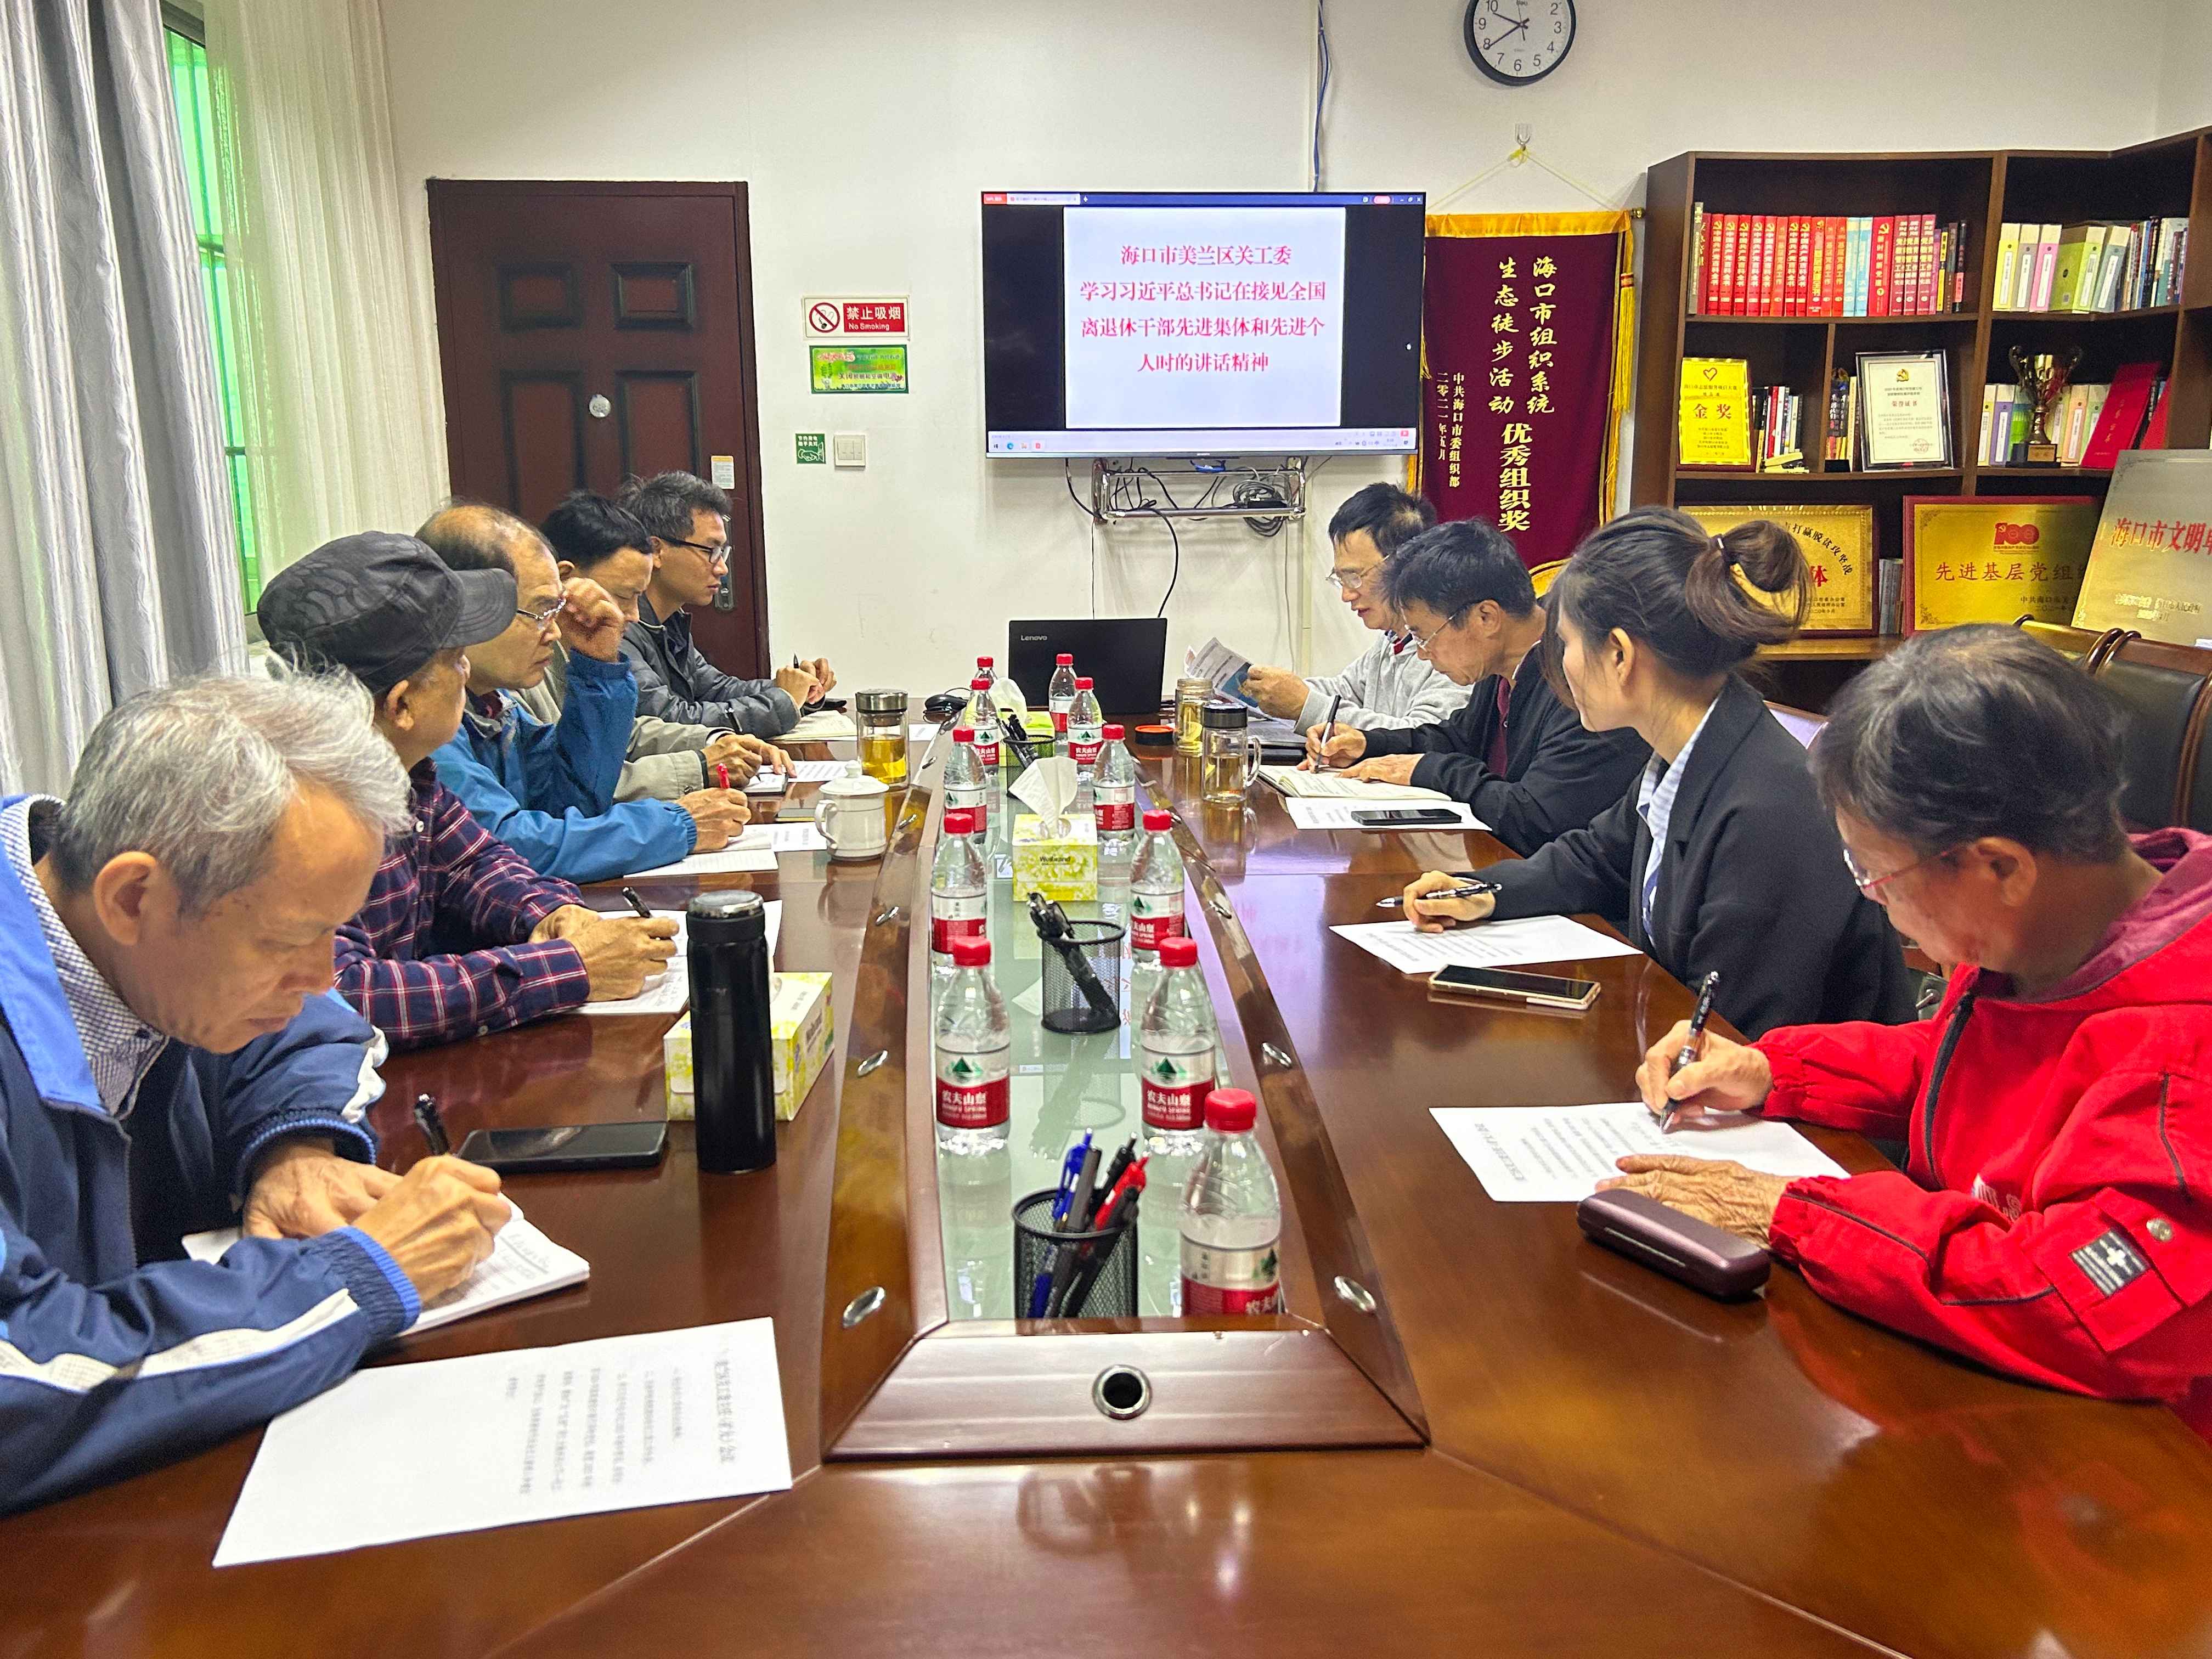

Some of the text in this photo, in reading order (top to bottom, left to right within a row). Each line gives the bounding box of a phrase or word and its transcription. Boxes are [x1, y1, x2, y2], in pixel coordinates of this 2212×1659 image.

[1486, 0, 1498, 12] 10
[1550, 3, 1559, 15] 2
[1479, 18, 1487, 30] 9
[1554, 21, 1562, 34] 3
[1483, 38, 1491, 50] 8
[1547, 41, 1554, 53] 4
[1497, 52, 1505, 65] 7
[1514, 59, 1522, 71] 6
[1533, 54, 1541, 67] 5
[1120, 245, 1293, 266] 海口市美兰区关工委
[1080, 281, 1326, 302] 学习习近平总书记在接见全国
[847, 306, 901, 320] 禁止吸烟
[1081, 317, 1325, 337] 离退休干部先进集体和先进个
[1527, 256, 1558, 414] 海口市组织系统
[1488, 256, 1519, 415] 生态徒步活动
[1138, 352, 1269, 373] 人时的讲话精神
[1437, 373, 1449, 461] 二零二一年五月
[1693, 403, 1732, 420] 金奖
[1449, 372, 1465, 488] 中共海口市委组织部
[1498, 422, 1533, 532] 优秀组织奖
[942, 1089, 986, 1105] 农夫山泉
[1147, 1089, 1190, 1106] 农夫山泉
